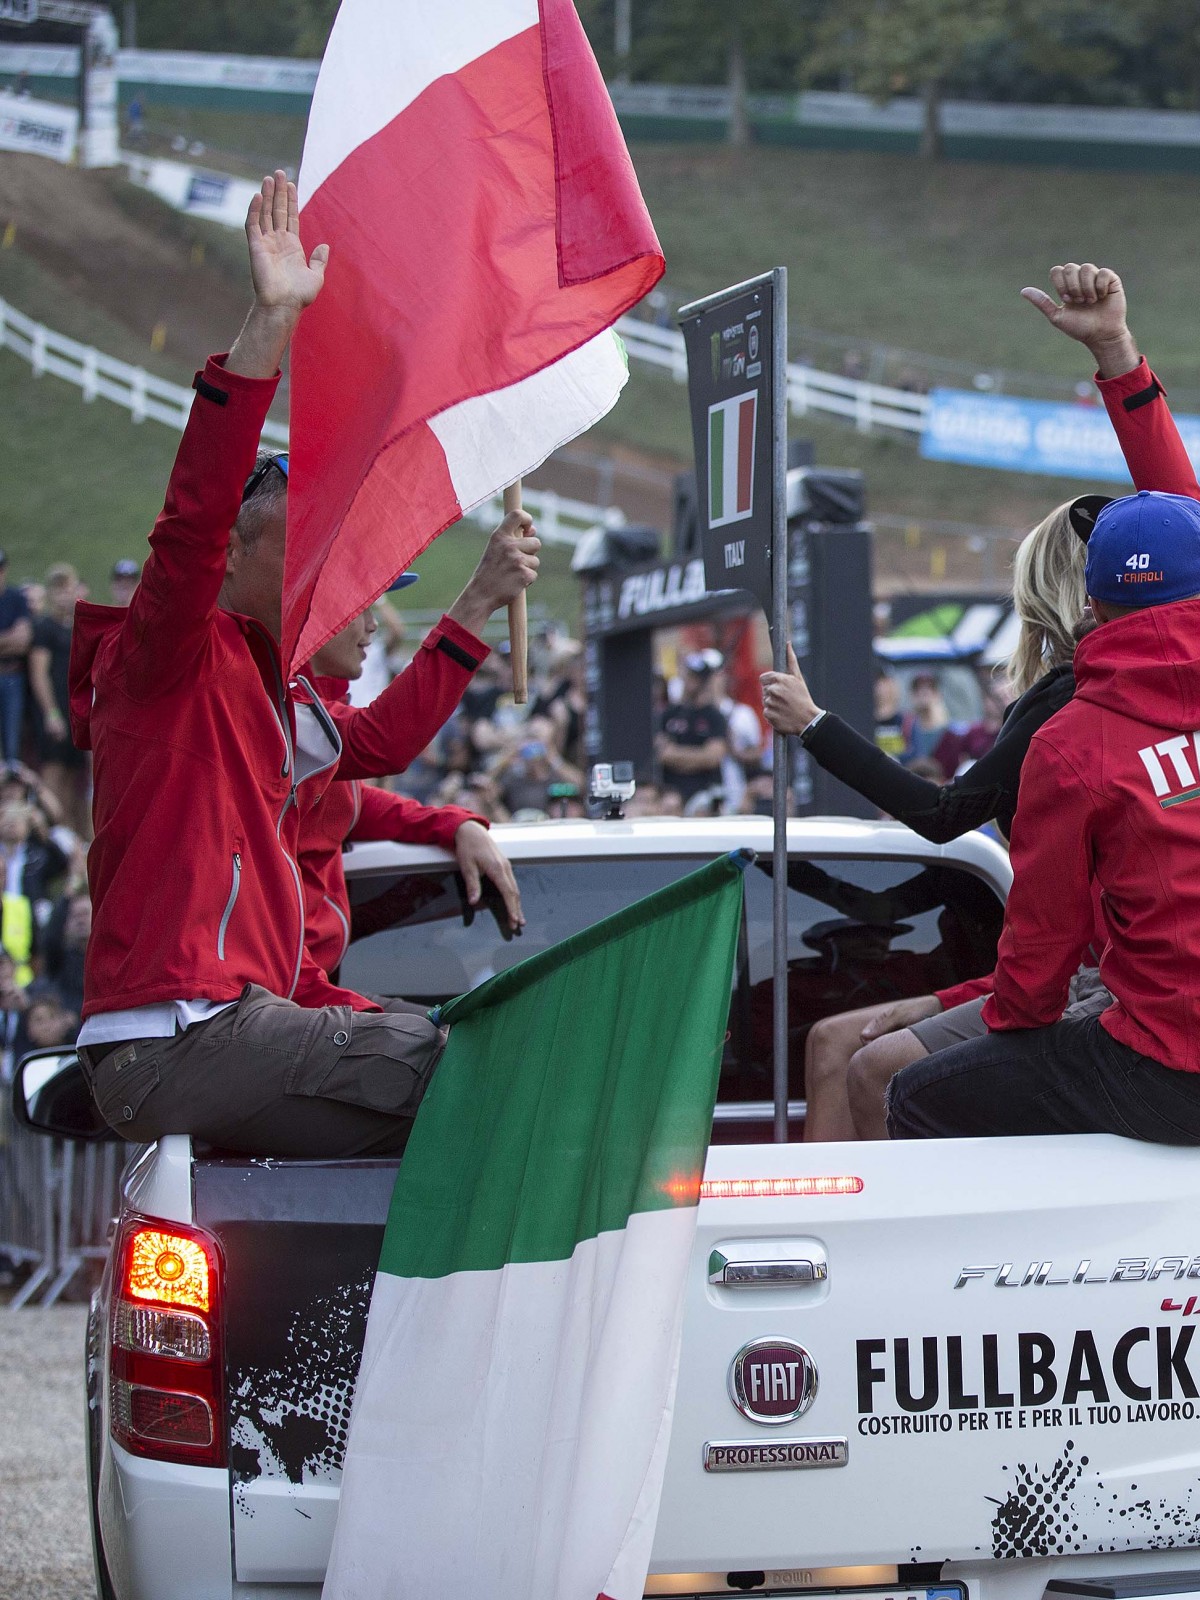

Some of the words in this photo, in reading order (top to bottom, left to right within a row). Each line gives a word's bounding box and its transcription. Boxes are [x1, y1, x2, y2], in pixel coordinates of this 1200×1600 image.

[724, 540, 745, 569] ITALY
[1125, 553, 1150, 570] 40
[1123, 571, 1163, 583] CAIROLI
[750, 1362, 799, 1402] FIAT
[856, 1324, 1200, 1414] FULLBACK
[857, 1412, 951, 1436] COSTRUITO
[958, 1411, 989, 1431] PER
[994, 1409, 1013, 1429] TE
[1018, 1409, 1028, 1428] E
[1032, 1407, 1063, 1427] PER
[1068, 1407, 1083, 1426] IL
[1087, 1405, 1122, 1425] TUO
[1126, 1401, 1200, 1423] LAVORO.
[715, 1446, 840, 1465] PROFESSIONAL
